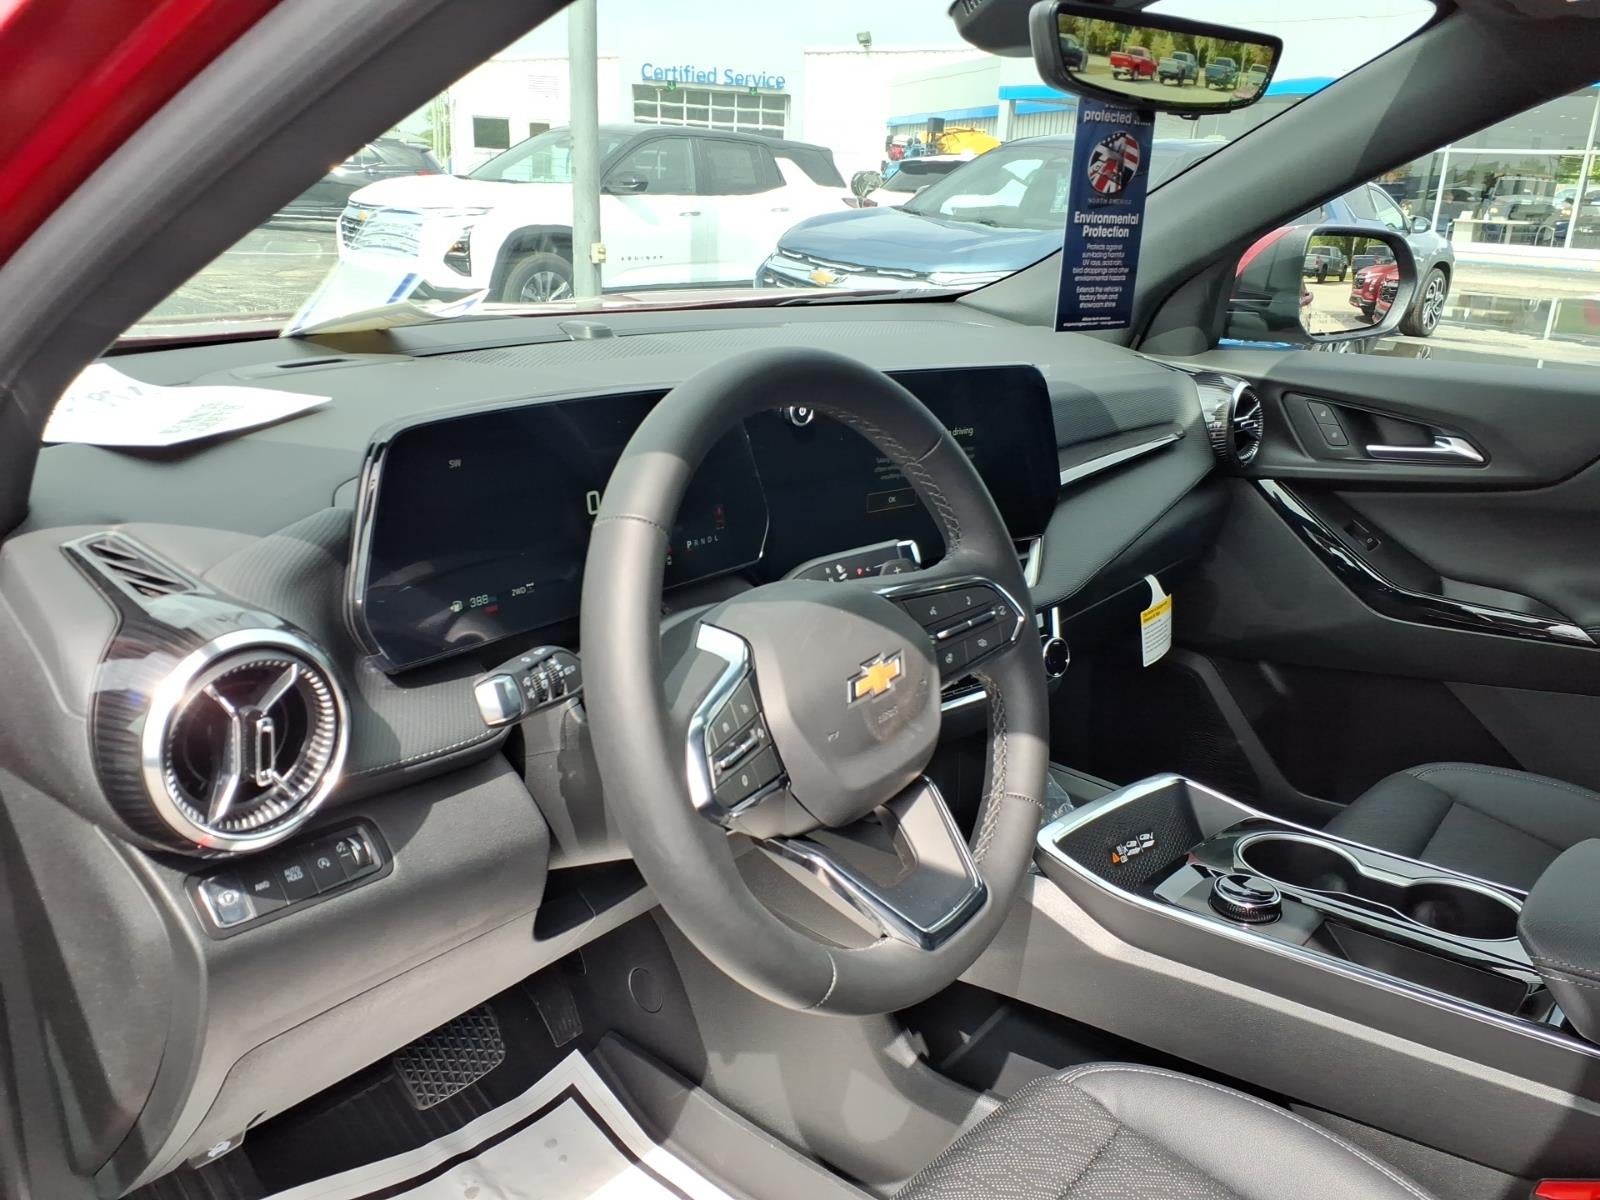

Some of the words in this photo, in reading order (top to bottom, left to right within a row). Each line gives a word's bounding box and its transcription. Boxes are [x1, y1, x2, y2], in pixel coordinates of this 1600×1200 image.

[641, 62, 717, 84] Certified
[723, 68, 786, 89] Service
[1083, 109, 1132, 124] protected
[1073, 210, 1140, 225] Environmental
[1082, 225, 1130, 238] Protection
[952, 427, 974, 437] driving
[469, 594, 489, 608] 388
[285, 866, 301, 877] AUTO
[287, 871, 304, 882] HOLD
